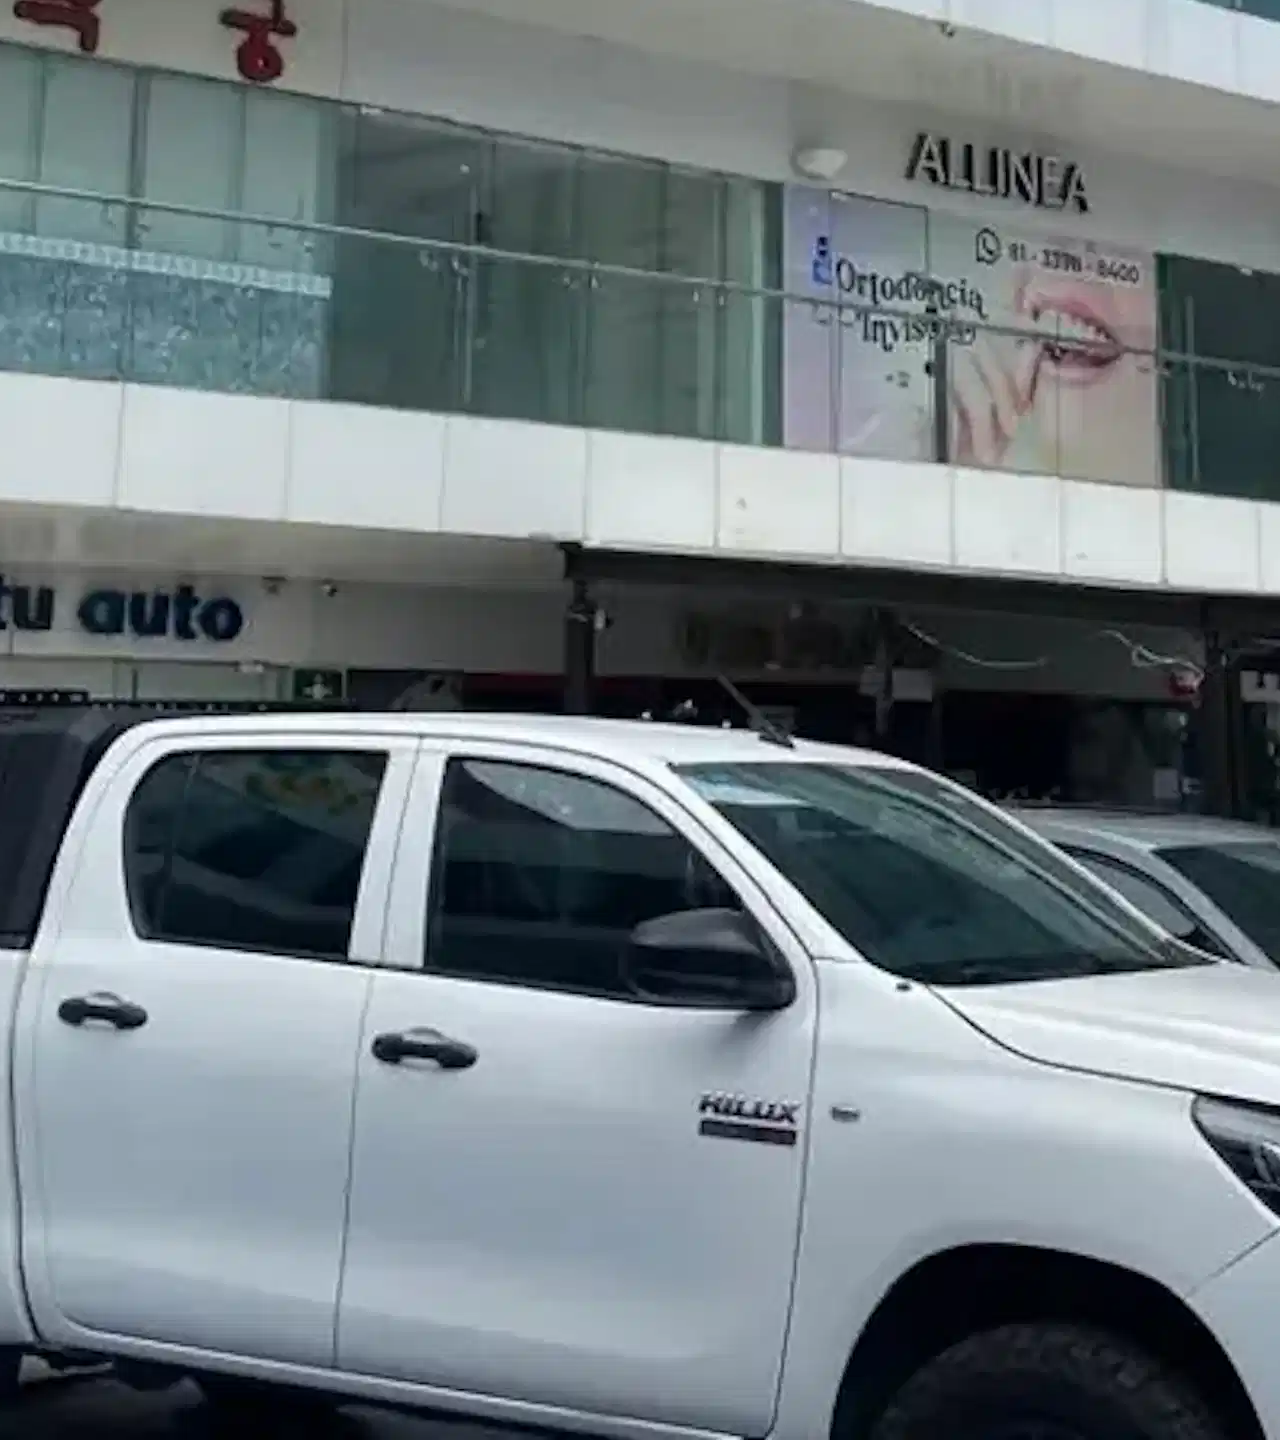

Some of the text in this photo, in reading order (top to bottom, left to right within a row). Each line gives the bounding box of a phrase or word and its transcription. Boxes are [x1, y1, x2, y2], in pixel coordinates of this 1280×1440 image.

[904, 131, 1091, 213] ALLINEA
[78, 580, 245, 642] auto
[697, 1091, 801, 1123] HILUX
